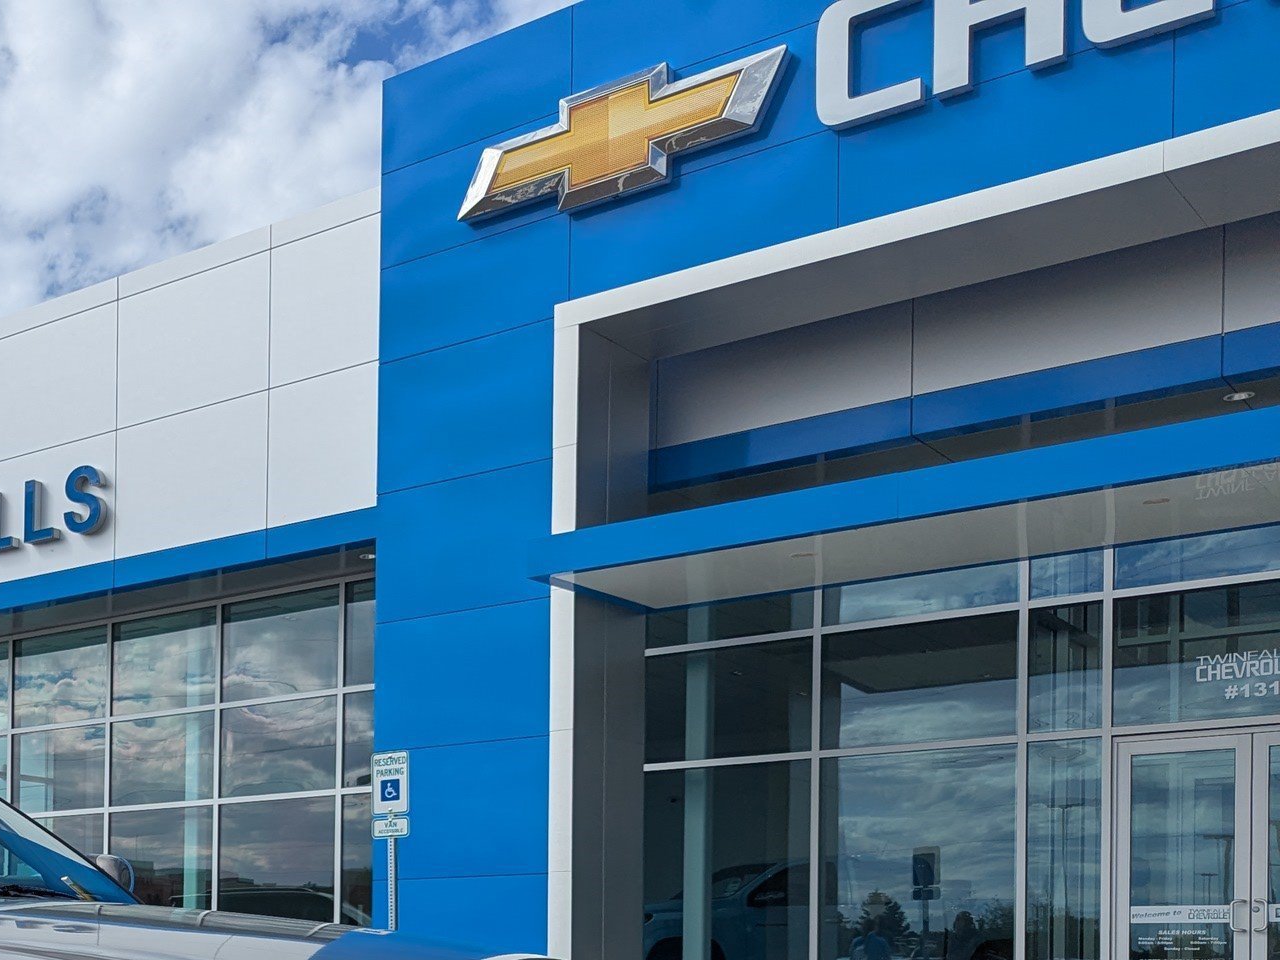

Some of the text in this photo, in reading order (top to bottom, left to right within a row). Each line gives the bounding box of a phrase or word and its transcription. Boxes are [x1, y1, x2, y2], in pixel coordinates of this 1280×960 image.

[1225, 681, 1280, 699] #131
[374, 756, 406, 767] RESERVED
[376, 768, 404, 777] PARKING
